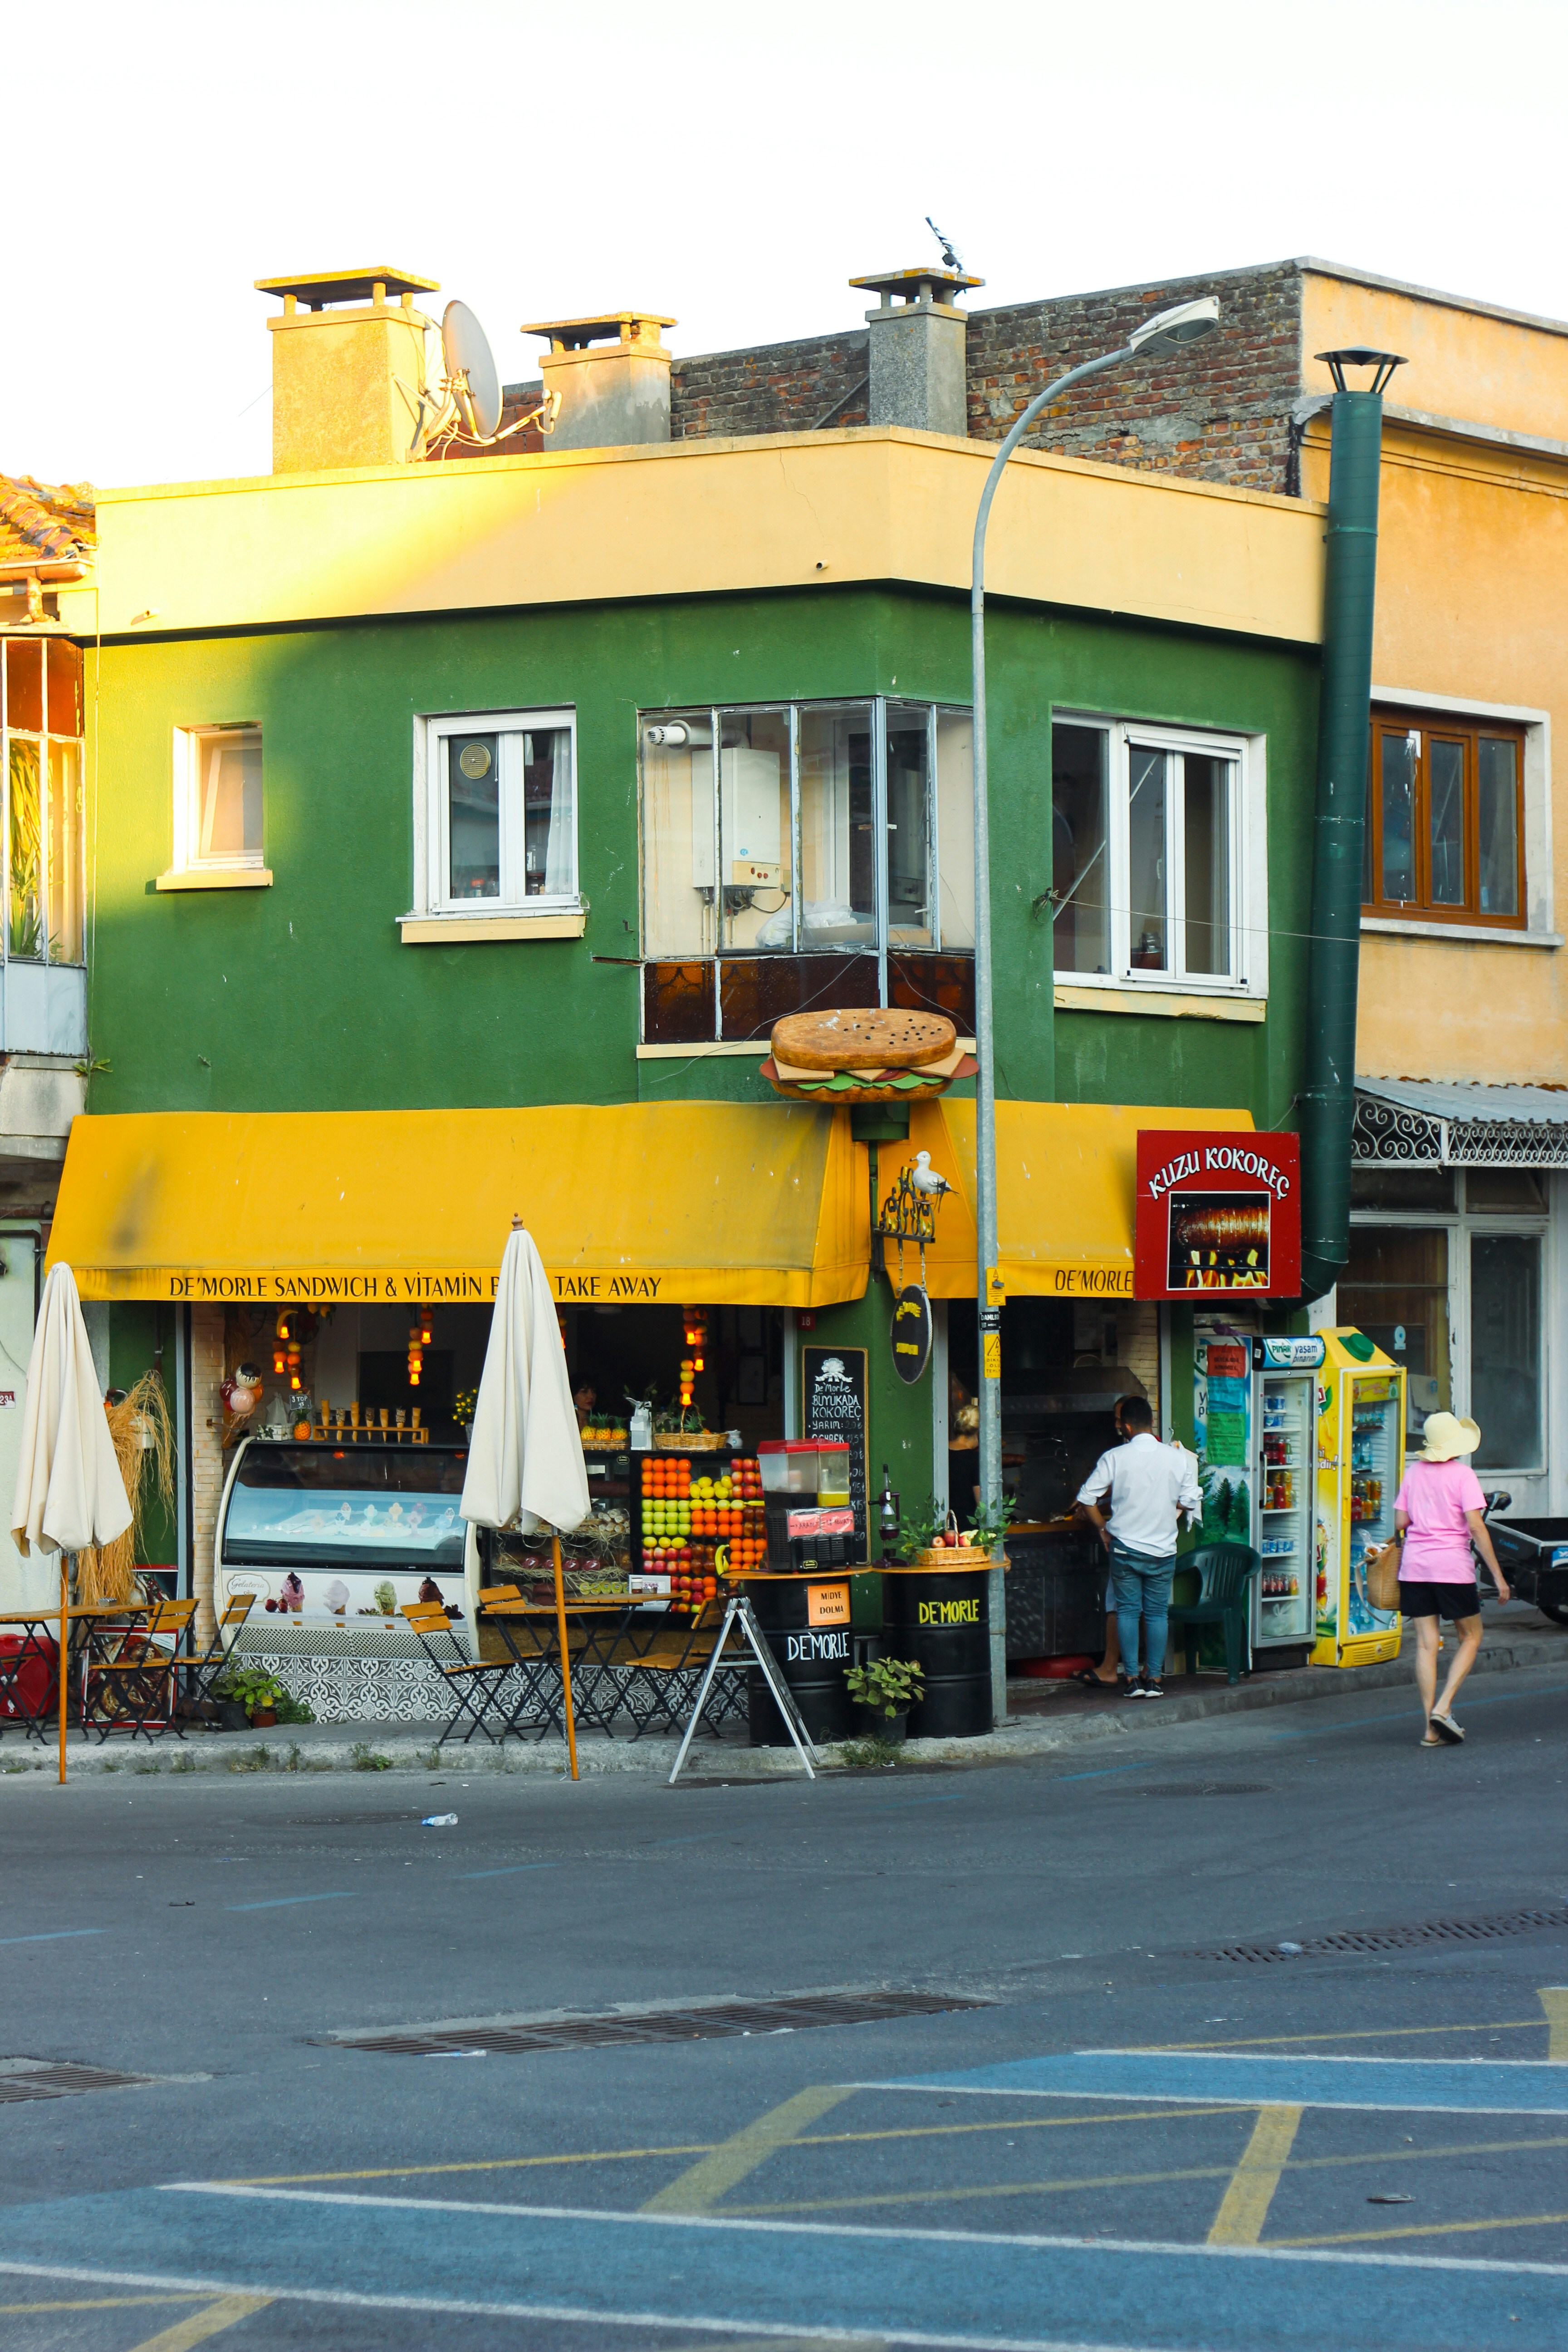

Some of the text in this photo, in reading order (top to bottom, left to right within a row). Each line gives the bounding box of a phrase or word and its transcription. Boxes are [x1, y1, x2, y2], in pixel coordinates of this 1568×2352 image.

[1149, 1147, 1289, 1200] KUZU KOKOREÇ
[170, 1277, 267, 1297] DE'MORLE
[275, 1277, 377, 1297] SANDWICH
[385, 1278, 397, 1297] &
[405, 1272, 482, 1297] VİTAMİN
[554, 1276, 662, 1297] TAKE AWAY
[1055, 1269, 1132, 1292] DE'MORLE
[1295, 1345, 1318, 1356] yaşam
[812, 1392, 859, 1406] BÜYÜKADA
[813, 1406, 862, 1421] KOKOREÇ
[231, 1578, 265, 1590] Gelateria
[821, 1591, 843, 1600] MİDYE
[820, 1605, 844, 1614] DOLMA
[919, 1599, 980, 1624] DE'MORLE
[788, 1632, 850, 1661] DE'MORLE
